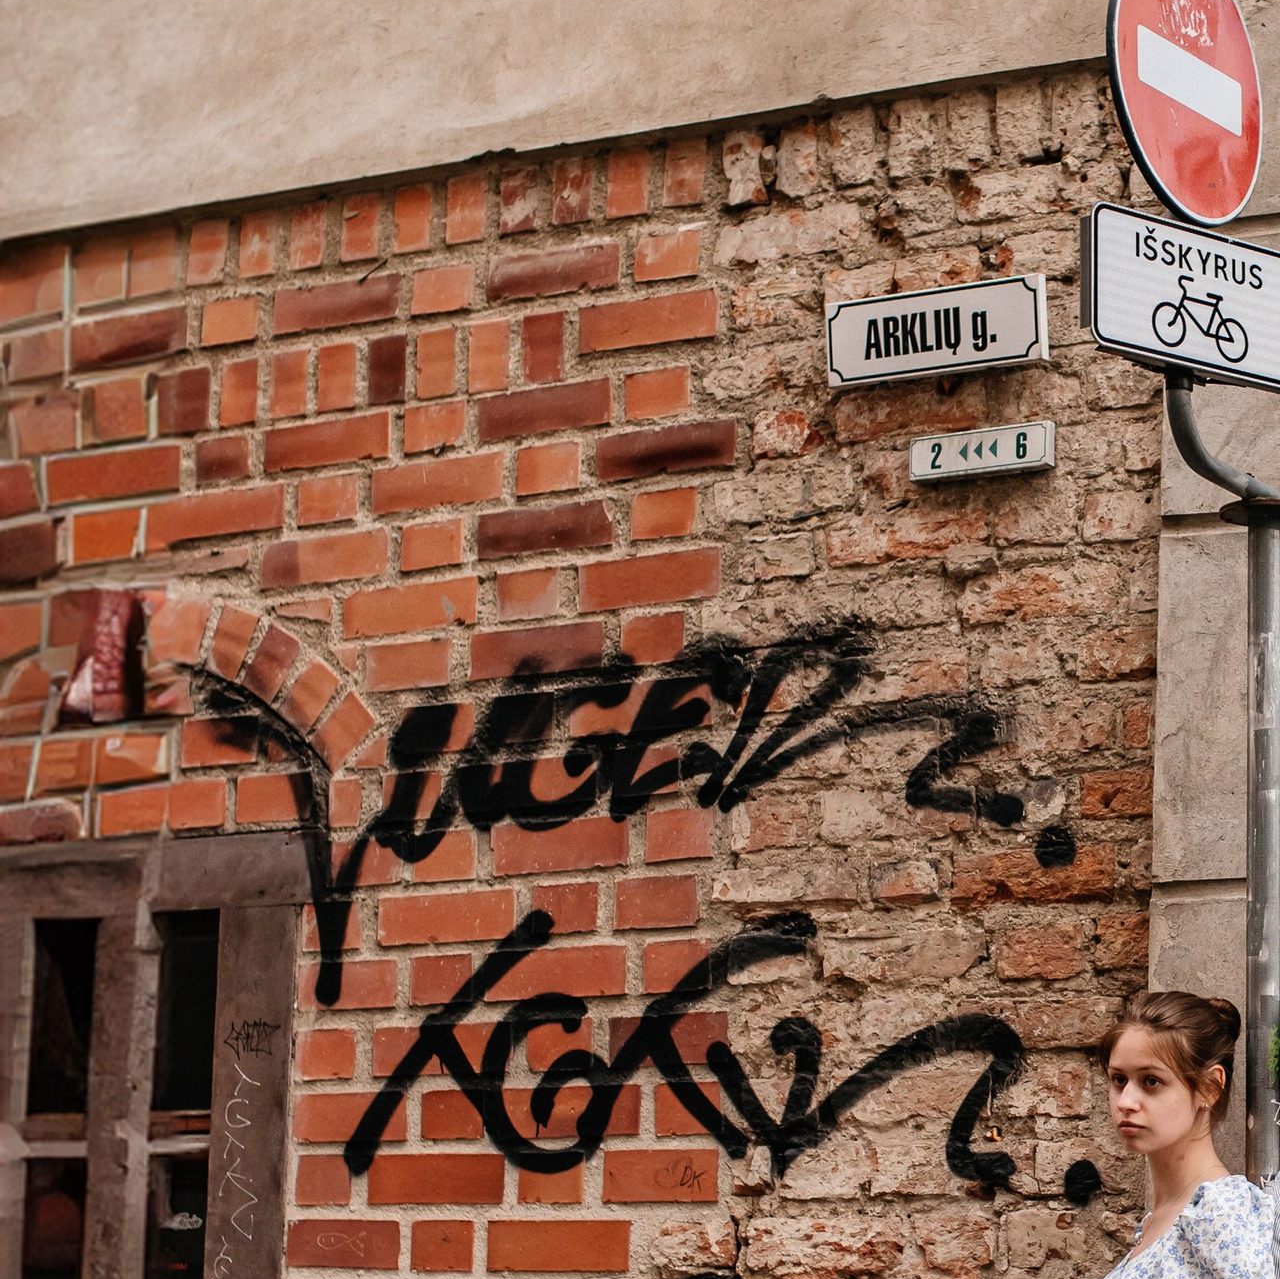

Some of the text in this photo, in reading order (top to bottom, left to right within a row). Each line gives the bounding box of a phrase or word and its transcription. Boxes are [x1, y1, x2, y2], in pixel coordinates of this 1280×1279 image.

[1135, 225, 1263, 290] IŠSKYRUS
[864, 306, 997, 361] ARKLIŲ g.
[930, 431, 1028, 470] 2 6
